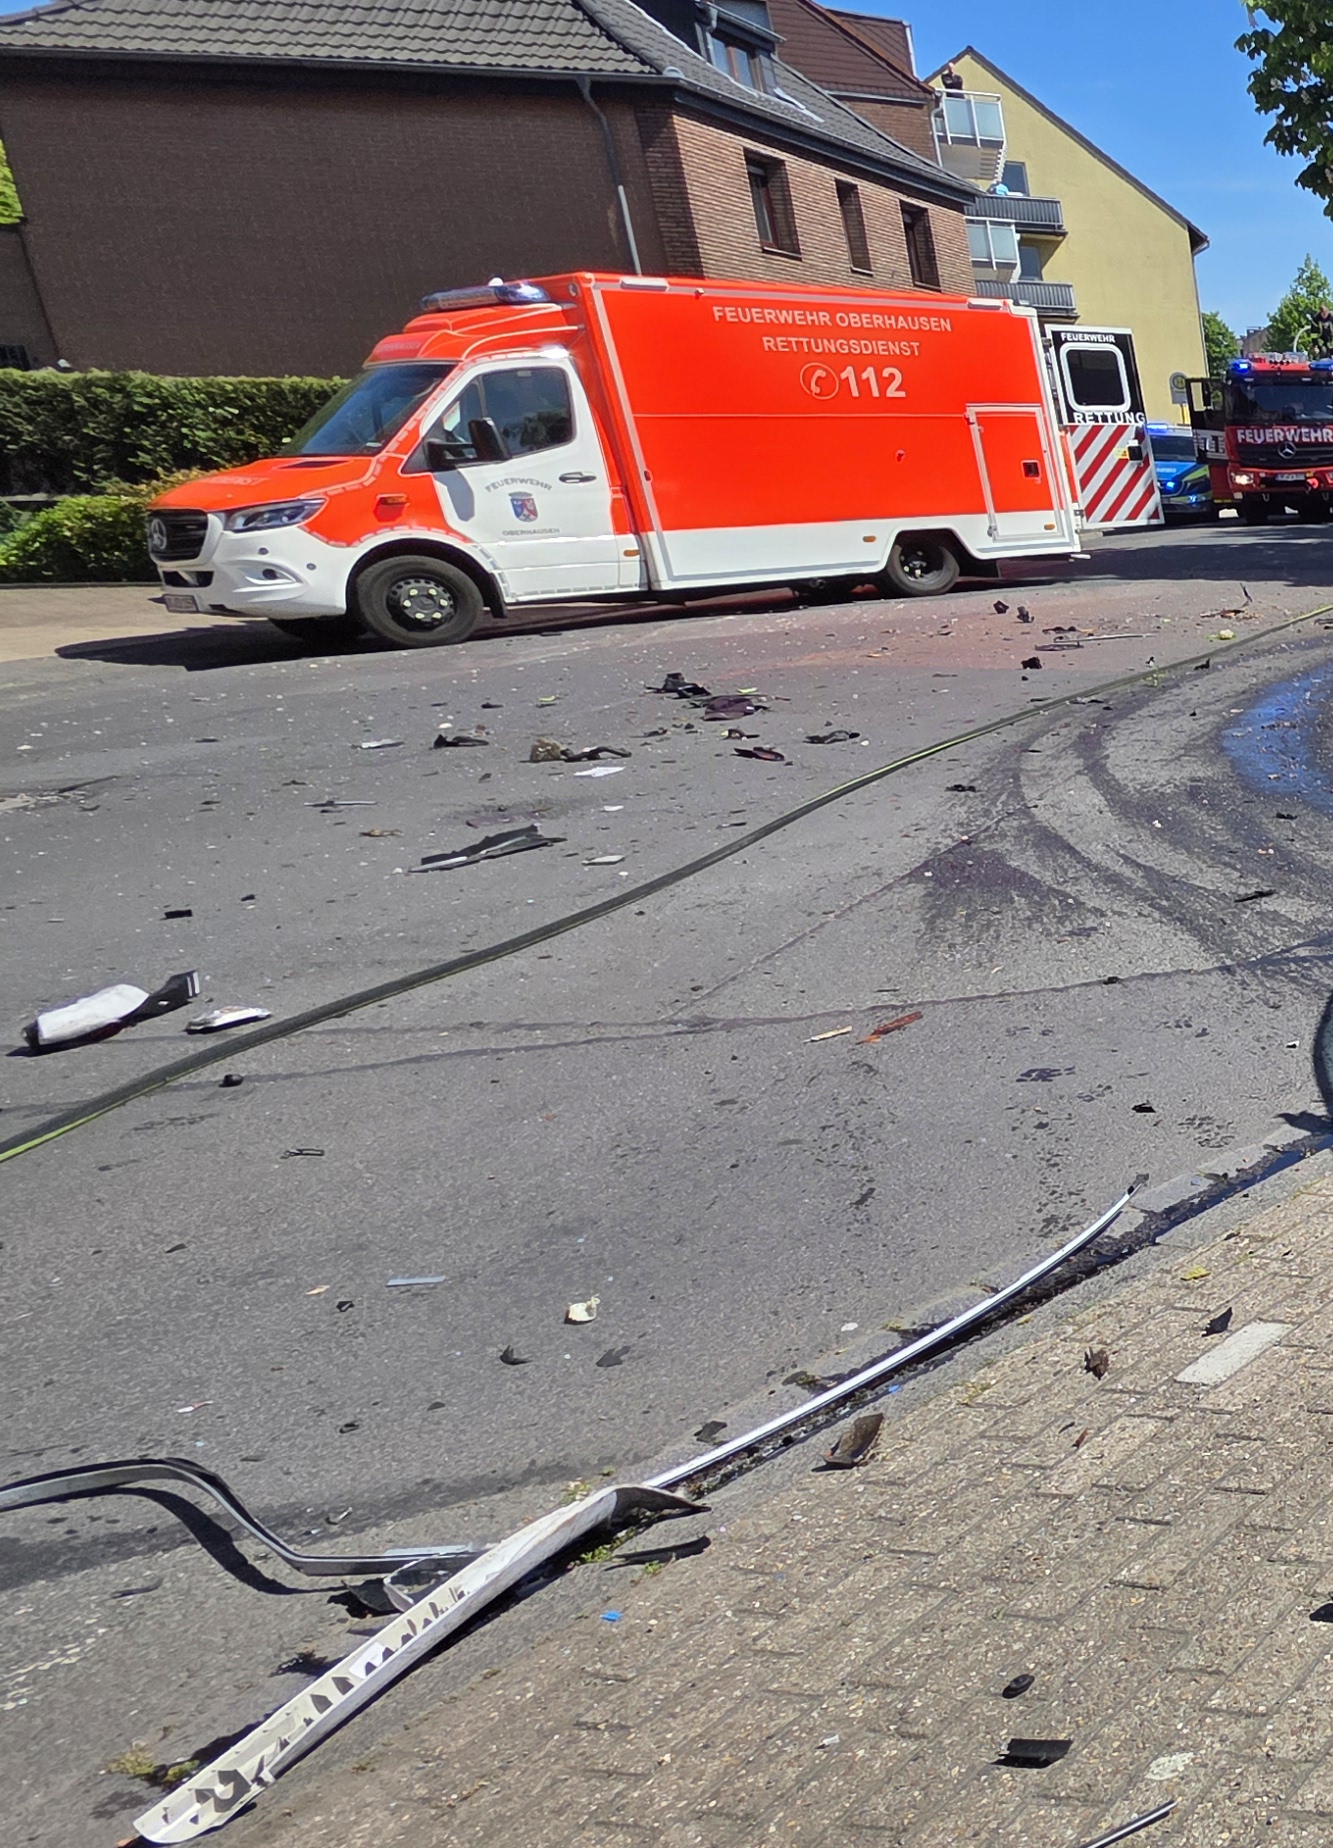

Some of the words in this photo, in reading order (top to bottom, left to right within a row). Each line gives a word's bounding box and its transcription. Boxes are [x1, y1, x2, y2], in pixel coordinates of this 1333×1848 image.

[712, 306, 832, 327] FEUERWEHR
[835, 312, 952, 332] OBERHAUSEN
[1060, 332, 1116, 344] FEUERWEHR
[762, 336, 921, 357] RETTUNGSDIENST
[840, 365, 907, 398] 112
[1073, 411, 1145, 424] RETTUNG
[484, 477, 553, 493] FEUERWEHR
[501, 528, 561, 537] OBERHAUSEN
